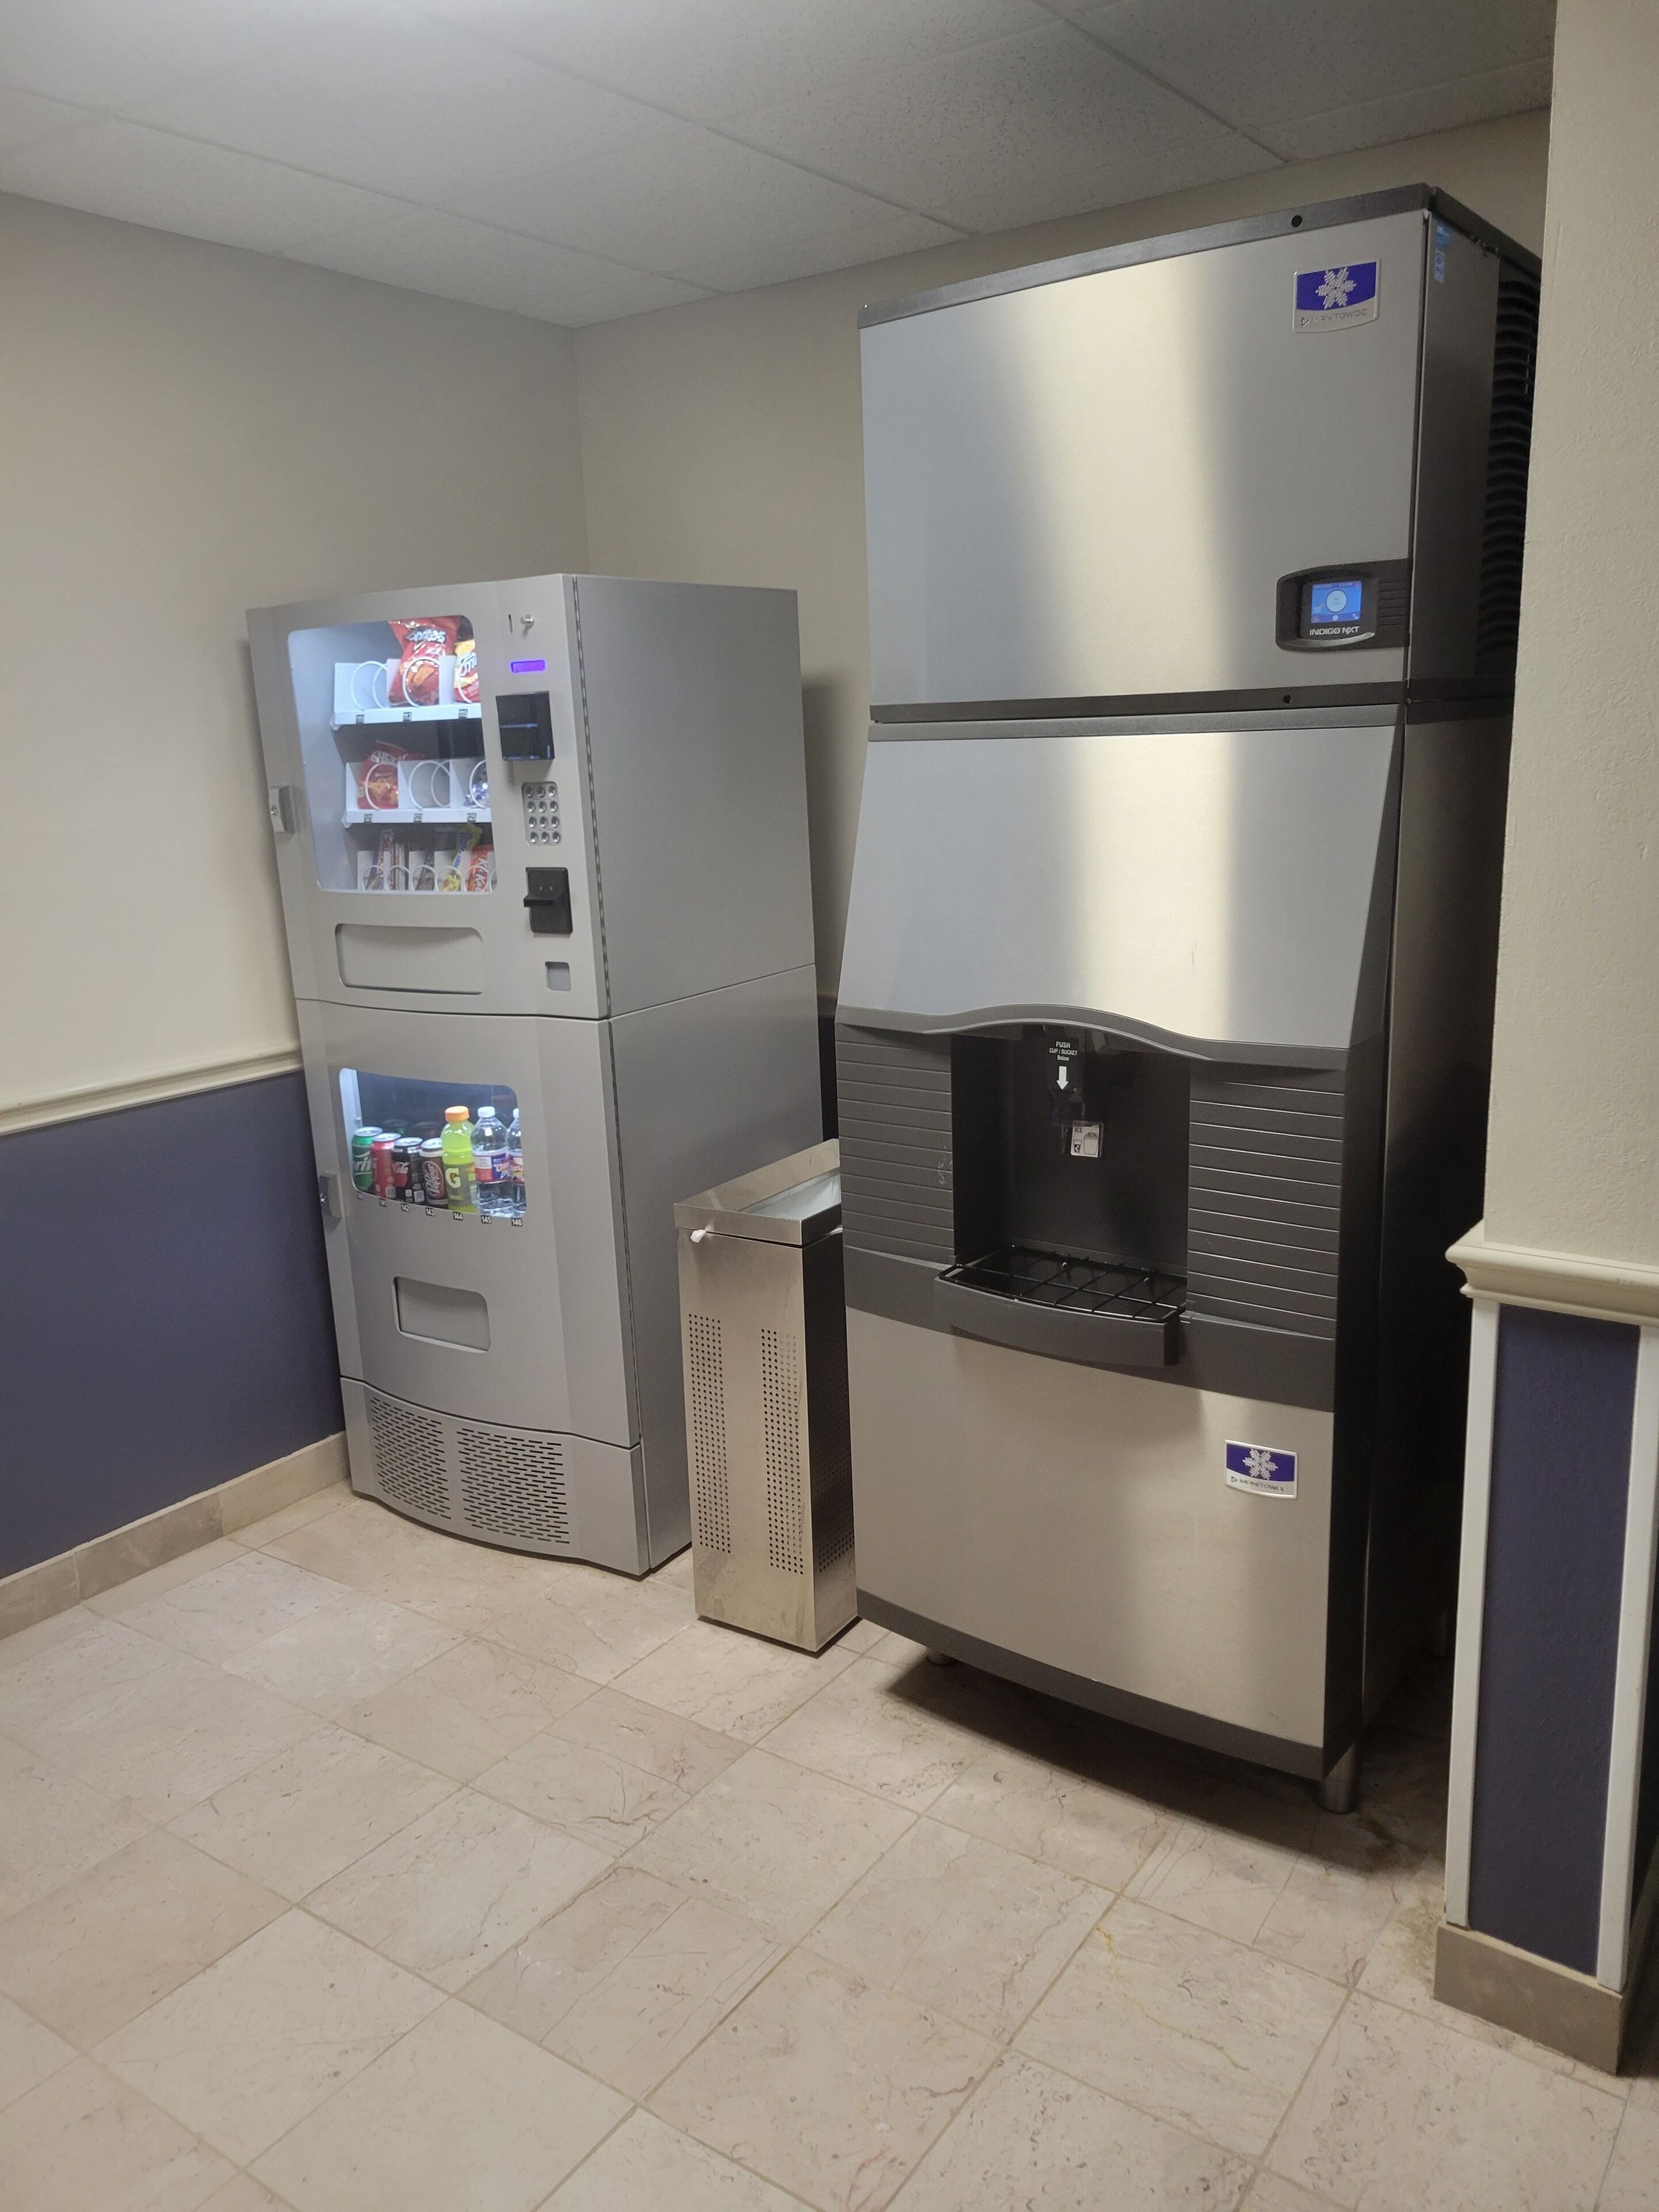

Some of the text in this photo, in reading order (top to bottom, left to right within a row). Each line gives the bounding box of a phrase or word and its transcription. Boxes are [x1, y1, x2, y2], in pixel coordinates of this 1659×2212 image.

[1309, 626, 1359, 635] INDIGO NXT
[446, 1168, 461, 1188] G
